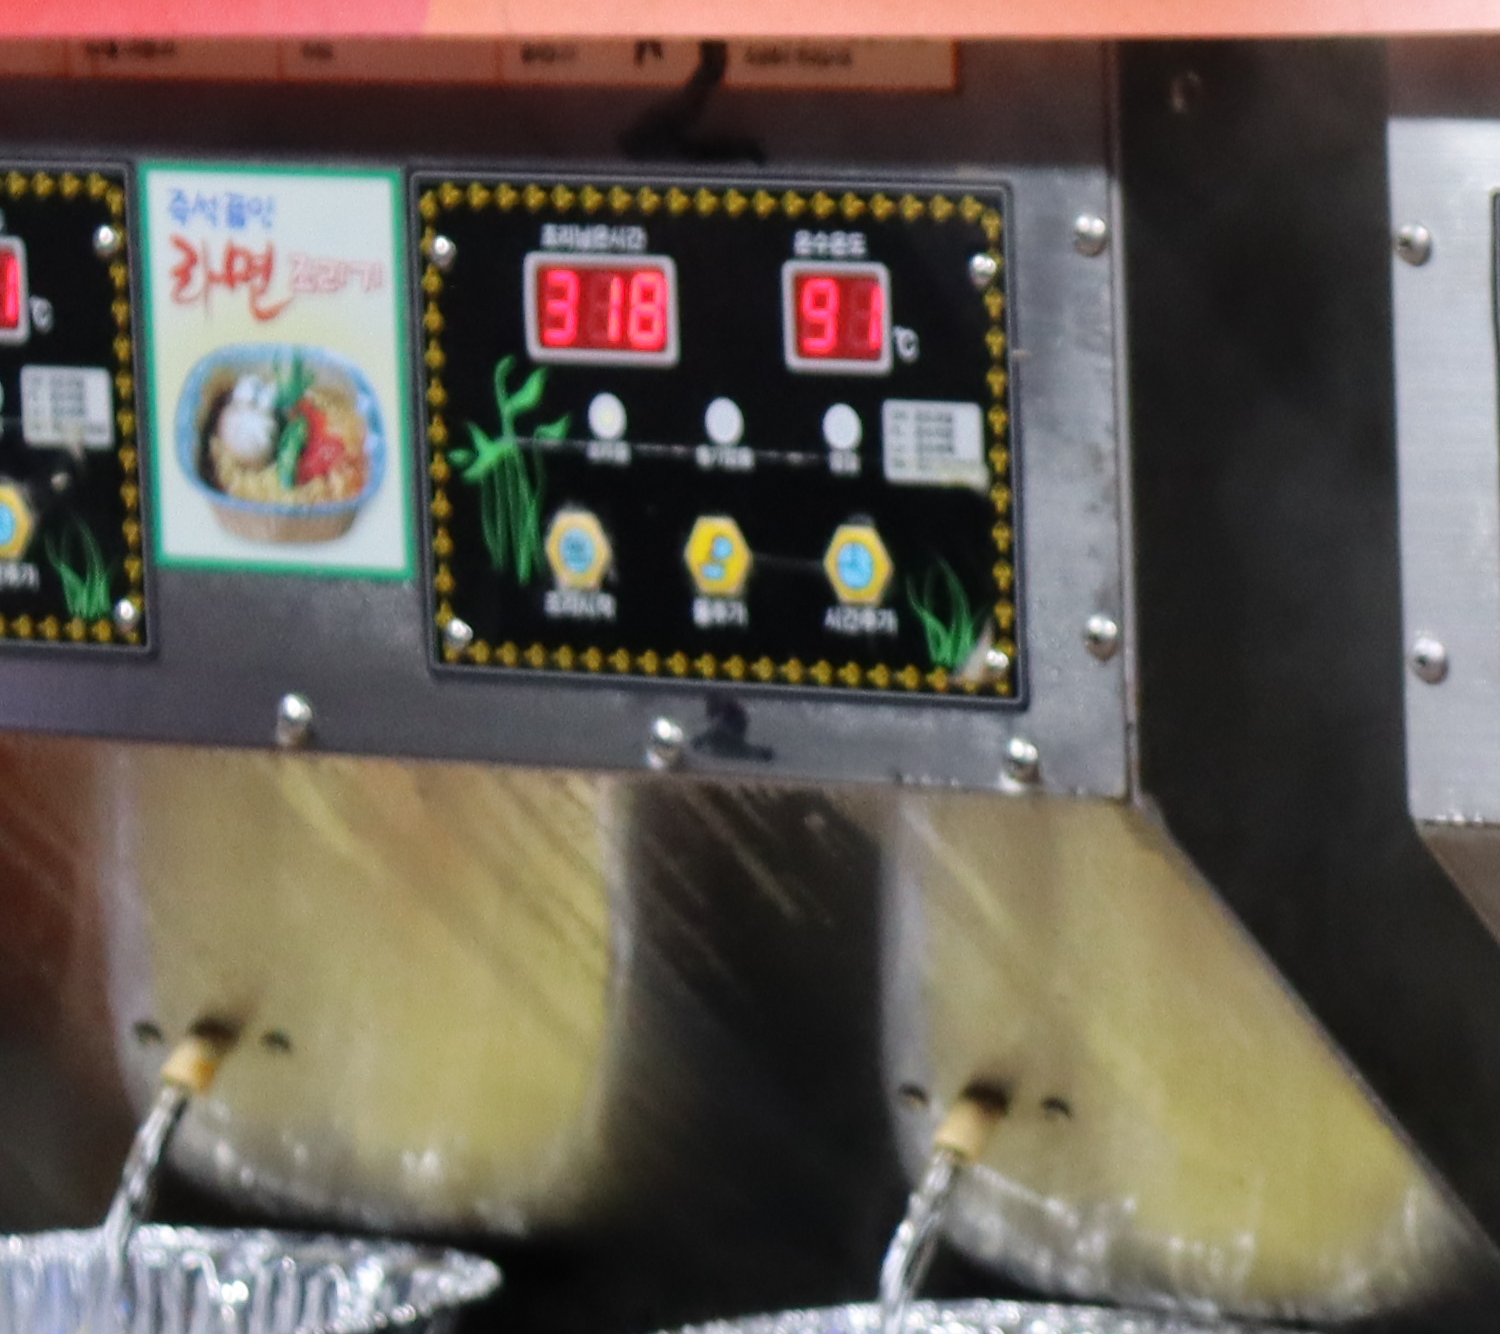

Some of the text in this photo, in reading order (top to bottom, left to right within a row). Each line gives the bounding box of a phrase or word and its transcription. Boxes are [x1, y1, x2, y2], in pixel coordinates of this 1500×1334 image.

[168, 237, 284, 321] 라면
[543, 269, 886, 355] 318 91
